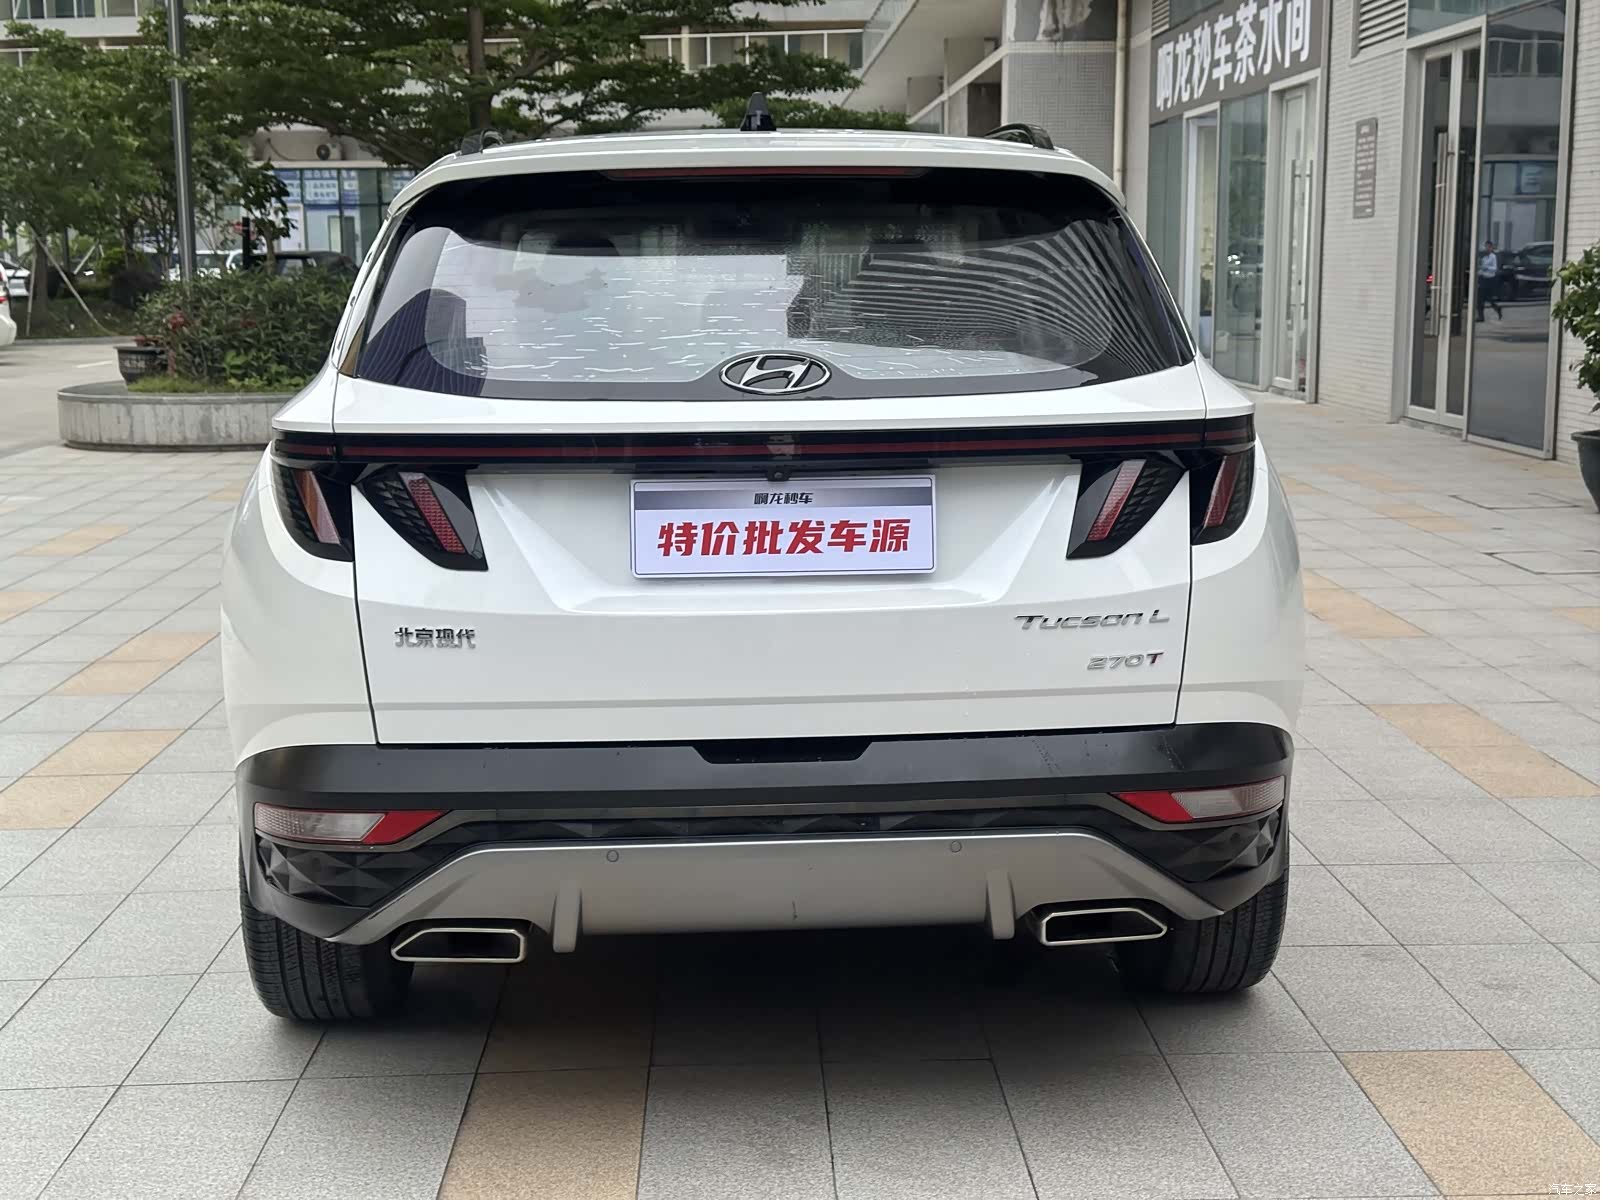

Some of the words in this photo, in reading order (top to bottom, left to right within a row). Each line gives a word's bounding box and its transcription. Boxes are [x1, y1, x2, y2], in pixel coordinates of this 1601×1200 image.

[1156, 0, 1311, 112] 啊龙秒车茶水间
[657, 518, 911, 557] 特价批发车源
[1149, 609, 1170, 624] L
[394, 627, 476, 649] 北京现代
[1087, 652, 1165, 670] 270T
